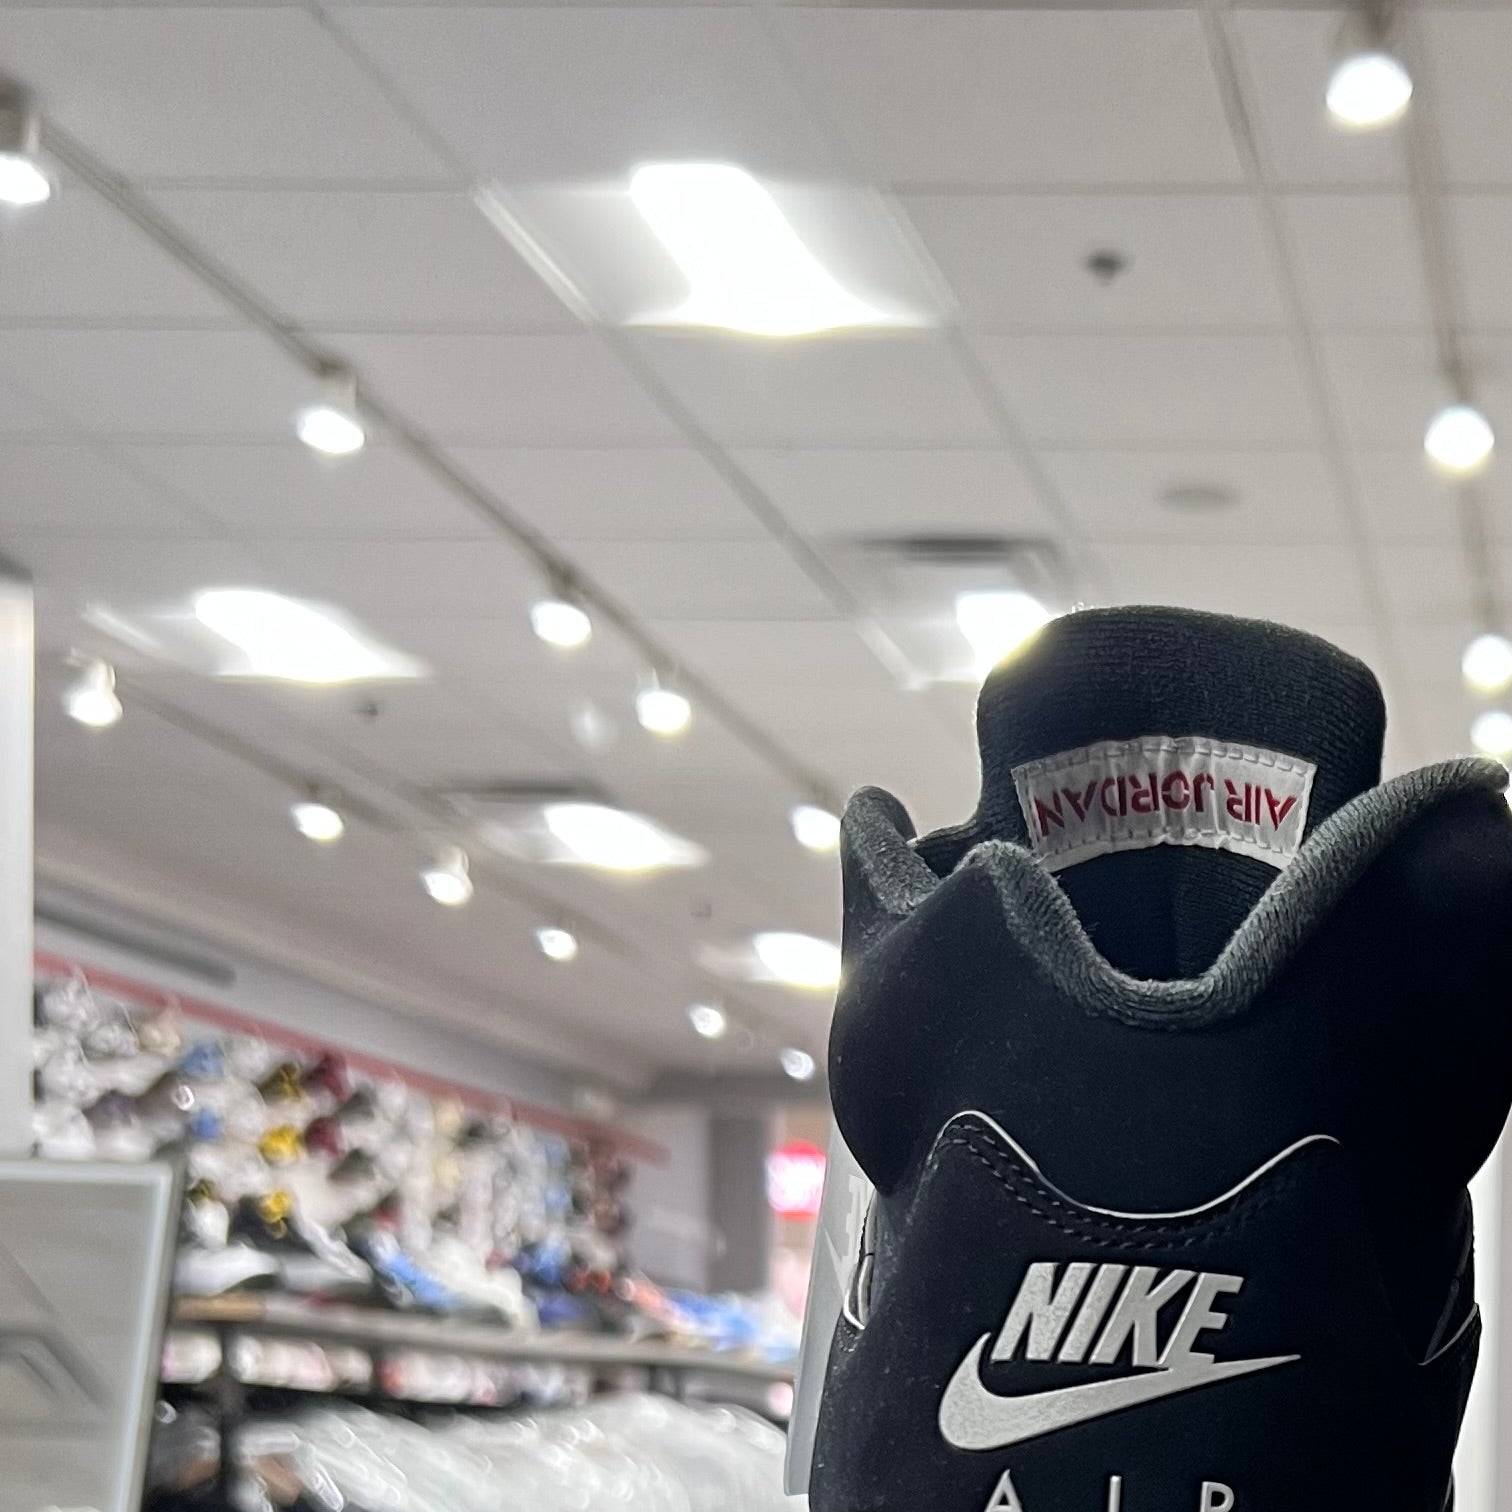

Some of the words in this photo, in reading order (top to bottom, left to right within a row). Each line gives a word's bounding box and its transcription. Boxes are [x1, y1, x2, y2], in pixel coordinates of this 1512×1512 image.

[1033, 770, 1215, 838] JORDAN
[1224, 778, 1298, 831] AIR
[990, 1261, 1245, 1369] NIKE
